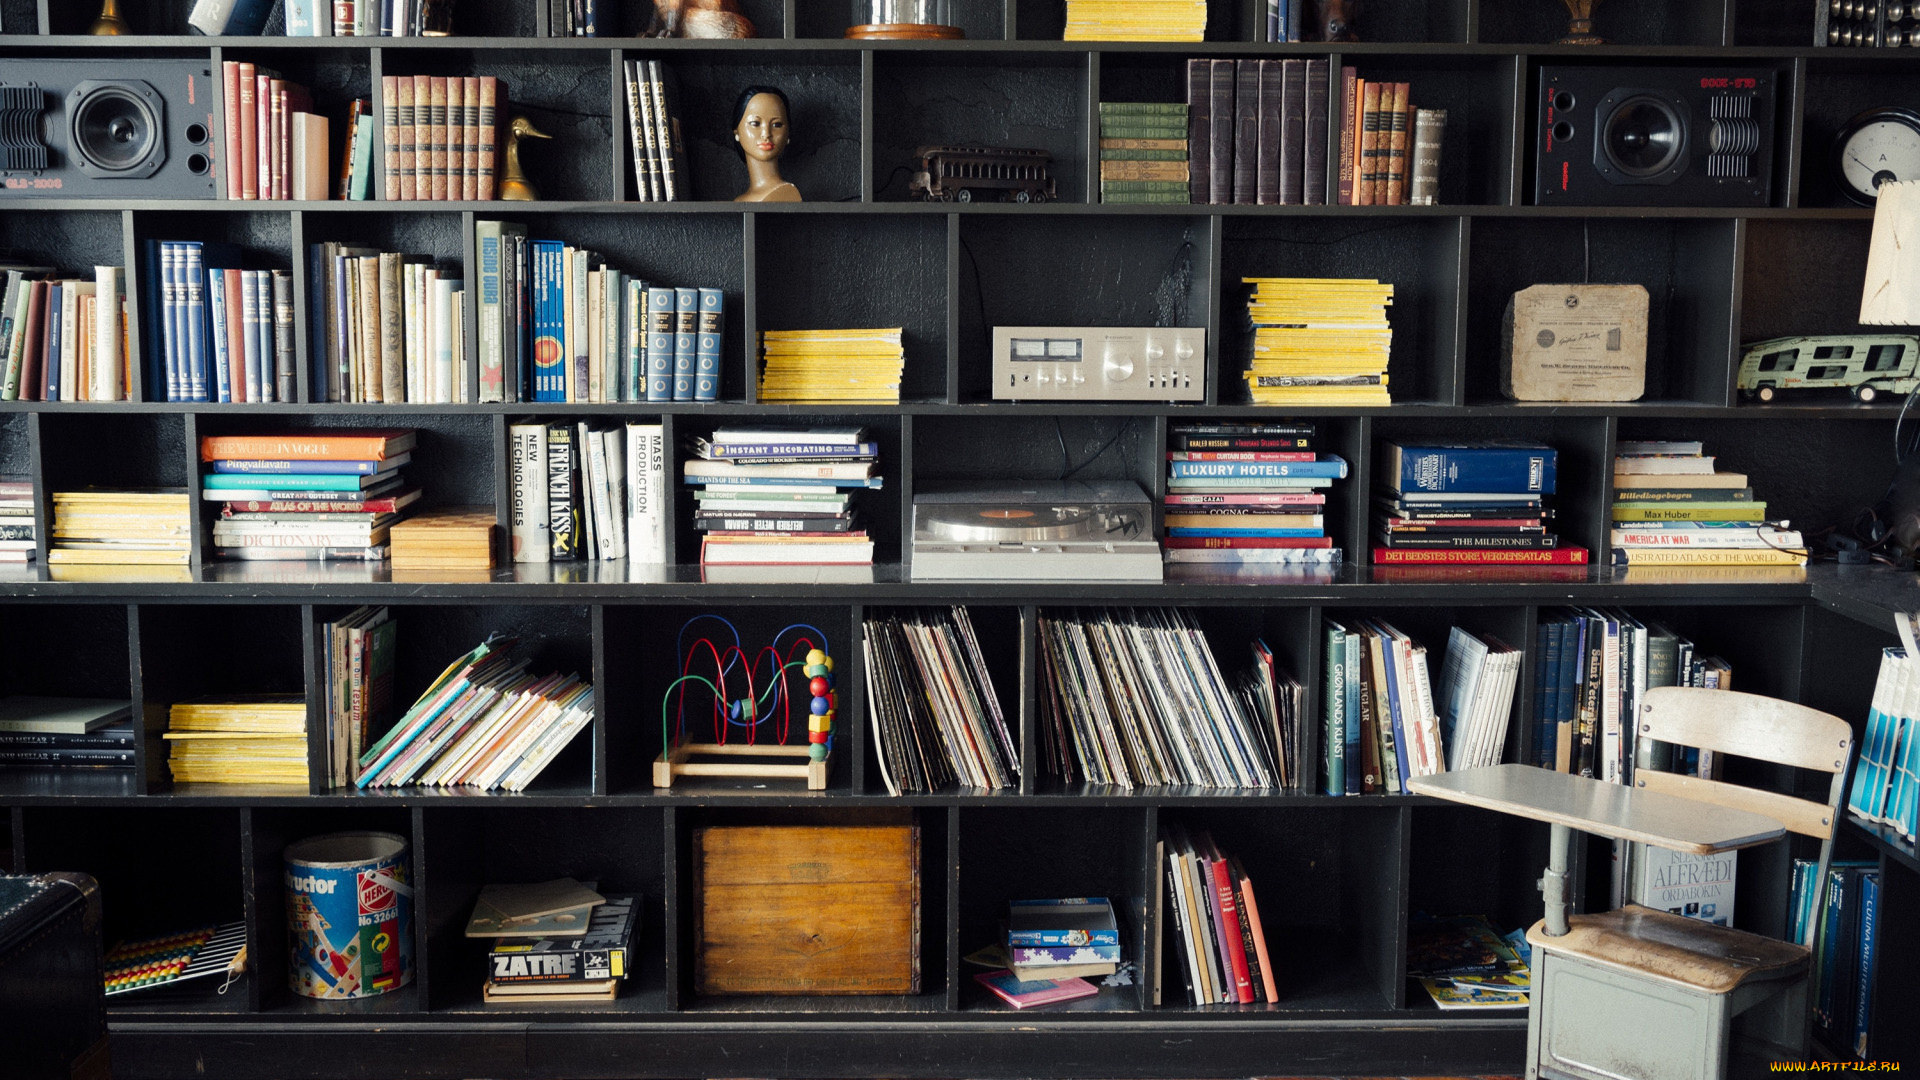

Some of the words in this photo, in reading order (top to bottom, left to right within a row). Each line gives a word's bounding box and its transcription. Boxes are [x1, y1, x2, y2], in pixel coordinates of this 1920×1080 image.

[1348, 116, 1354, 125] TO
[630, 126, 643, 149] SKIP
[643, 126, 655, 149] SKIP
[656, 126, 670, 149] SKIP
[366, 291, 376, 319] Outline
[212, 443, 231, 454] THE
[233, 443, 277, 454] WORLD
[277, 444, 291, 454] IN
[292, 444, 329, 455] VOGUE
[528, 434, 537, 462] NEW
[653, 435, 662, 471] MASS
[513, 434, 524, 526] TECHNOLOGIES
[549, 444, 570, 498] FRENCH
[638, 435, 647, 513] PRODUCTION
[1182, 465, 1235, 475] LUXURY
[1240, 465, 1288, 475] HOTELS
[1419, 457, 1428, 487] WEBSTER'S
[1431, 454, 1439, 490] DICTIONARY
[269, 501, 296, 511] ATLAS
[297, 501, 312, 511] OF
[312, 501, 329, 511] THE
[330, 502, 363, 511] WORLD
[550, 500, 571, 533] KISS
[724, 519, 749, 530] SAHARA
[754, 520, 775, 531] WEYER
[776, 521, 803, 531] HELFRIED
[243, 534, 332, 547] DICTIONARY
[1453, 537, 1472, 546] THE
[1474, 537, 1532, 546] MILESTONES
[1624, 535, 1659, 545] AMERICA
[1660, 535, 1670, 545] AT
[1672, 535, 1690, 545] WAR
[1385, 552, 1404, 561] DET
[1405, 552, 1447, 561] BEDSTES
[1449, 552, 1481, 561] STORE
[1482, 552, 1552, 561] VERDENSATLAS
[1682, 553, 1707, 562] ATLAS
[1710, 553, 1721, 562] OF
[1724, 553, 1742, 562] THE
[1745, 553, 1777, 562] WORLD
[1590, 649, 1600, 678] Saint
[1607, 638, 1618, 671] GUINNESS
[1684, 650, 1692, 666] Mine
[1607, 672, 1618, 690] BOOK
[1683, 666, 1691, 681] Eyes
[1334, 663, 1343, 724] GRØNLANDS
[1360, 681, 1370, 721] FUGLAR
[1418, 662, 1432, 718] REFLECTIONS
[352, 689, 361, 721] lesum
[1582, 681, 1599, 744] Petersburg
[1607, 701, 1618, 732] RECORDS
[1334, 727, 1343, 760] KUNST
[358, 915, 372, 926] No
[373, 908, 399, 925] 32661
[1864, 900, 1873, 941] CULINA
[1095, 935, 1116, 944] Disney
[1239, 932, 1254, 954] SKIP
[493, 954, 577, 977] ZATRE
[1858, 942, 1870, 1028] MEDITERRANEA
